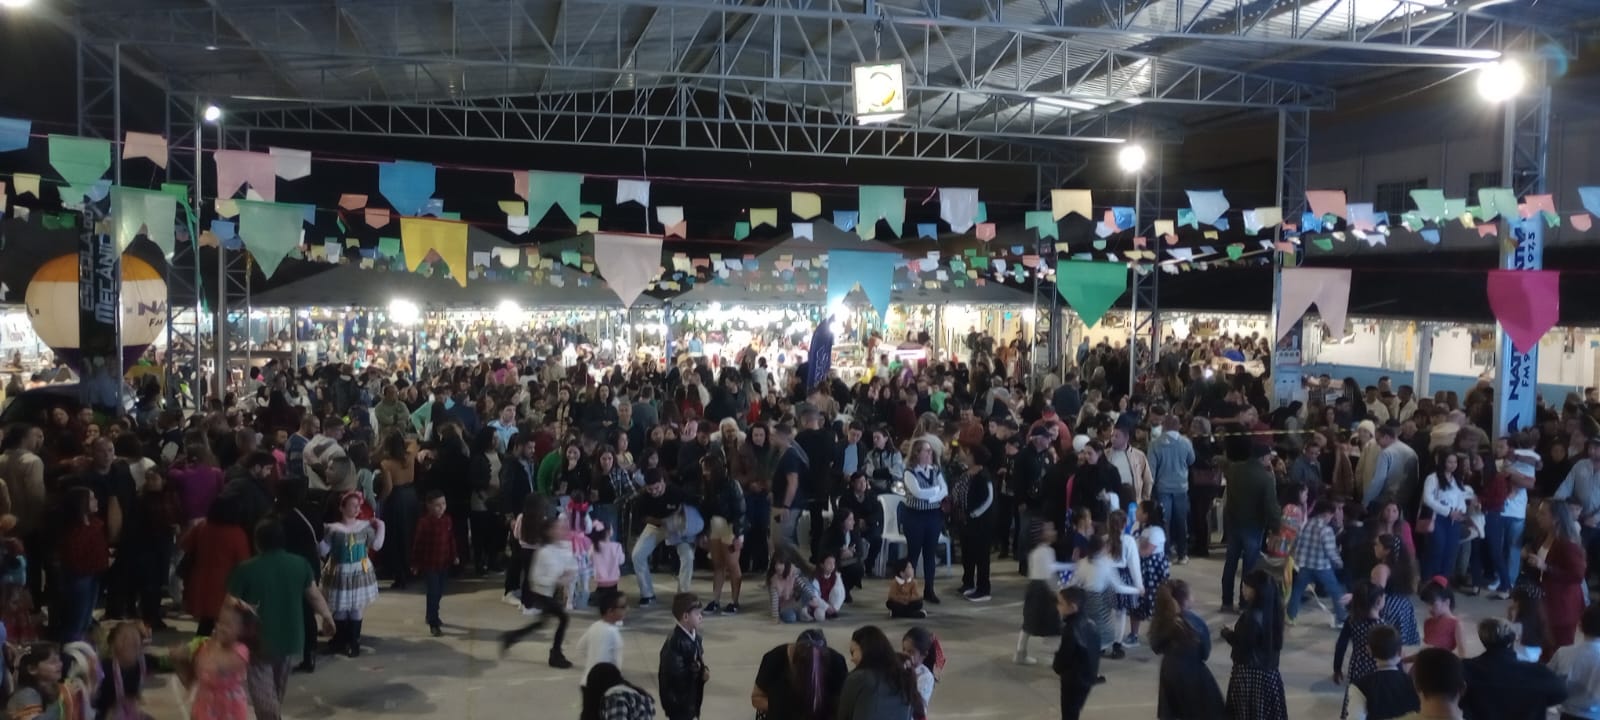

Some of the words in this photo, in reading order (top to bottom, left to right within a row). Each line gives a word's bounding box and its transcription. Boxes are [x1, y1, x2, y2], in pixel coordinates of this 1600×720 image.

[81, 232, 94, 312] ESCOLA
[94, 233, 114, 324] MECÂNIC
[138, 300, 166, 316] NA
[1521, 365, 1530, 388] FM
